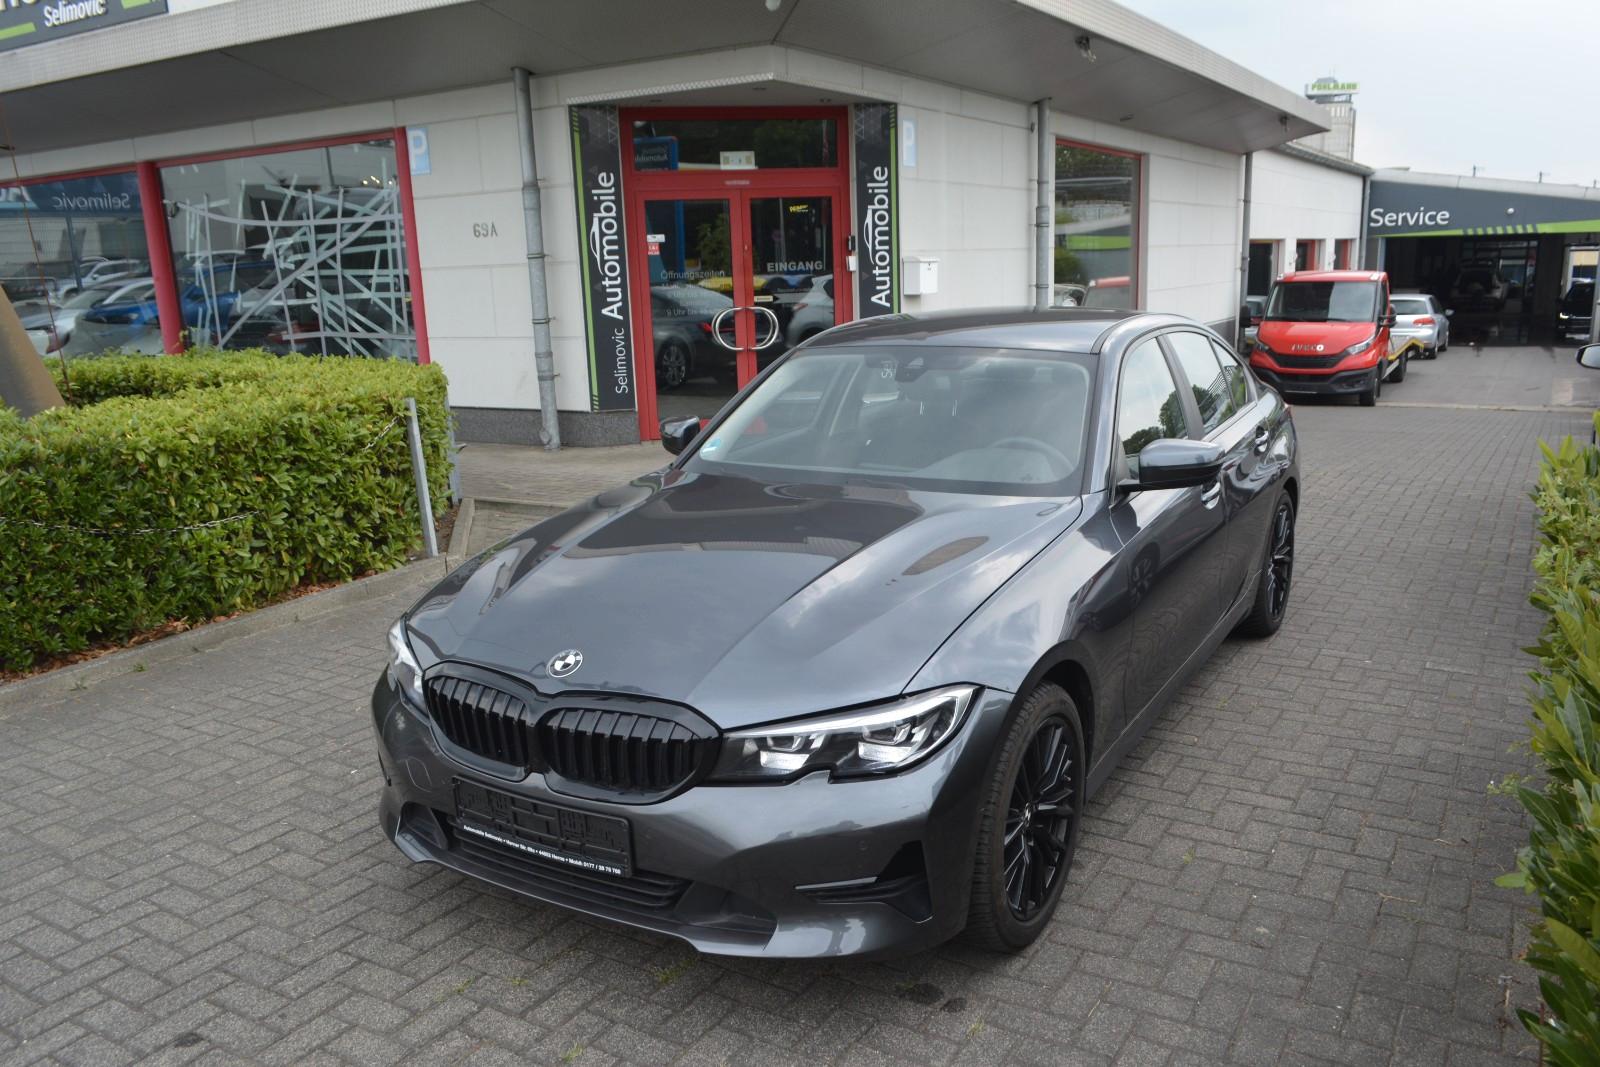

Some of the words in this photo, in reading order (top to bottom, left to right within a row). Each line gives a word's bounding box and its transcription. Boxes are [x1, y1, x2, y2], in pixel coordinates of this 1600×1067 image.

[43, 0, 107, 27] Selimovic
[1369, 206, 1450, 227] Service
[591, 172, 624, 321] Automobile
[867, 166, 891, 308] Automobile
[660, 269, 725, 280] Öffnungszeiten
[766, 261, 823, 272] EINGANG
[612, 328, 628, 394] Selimovic
